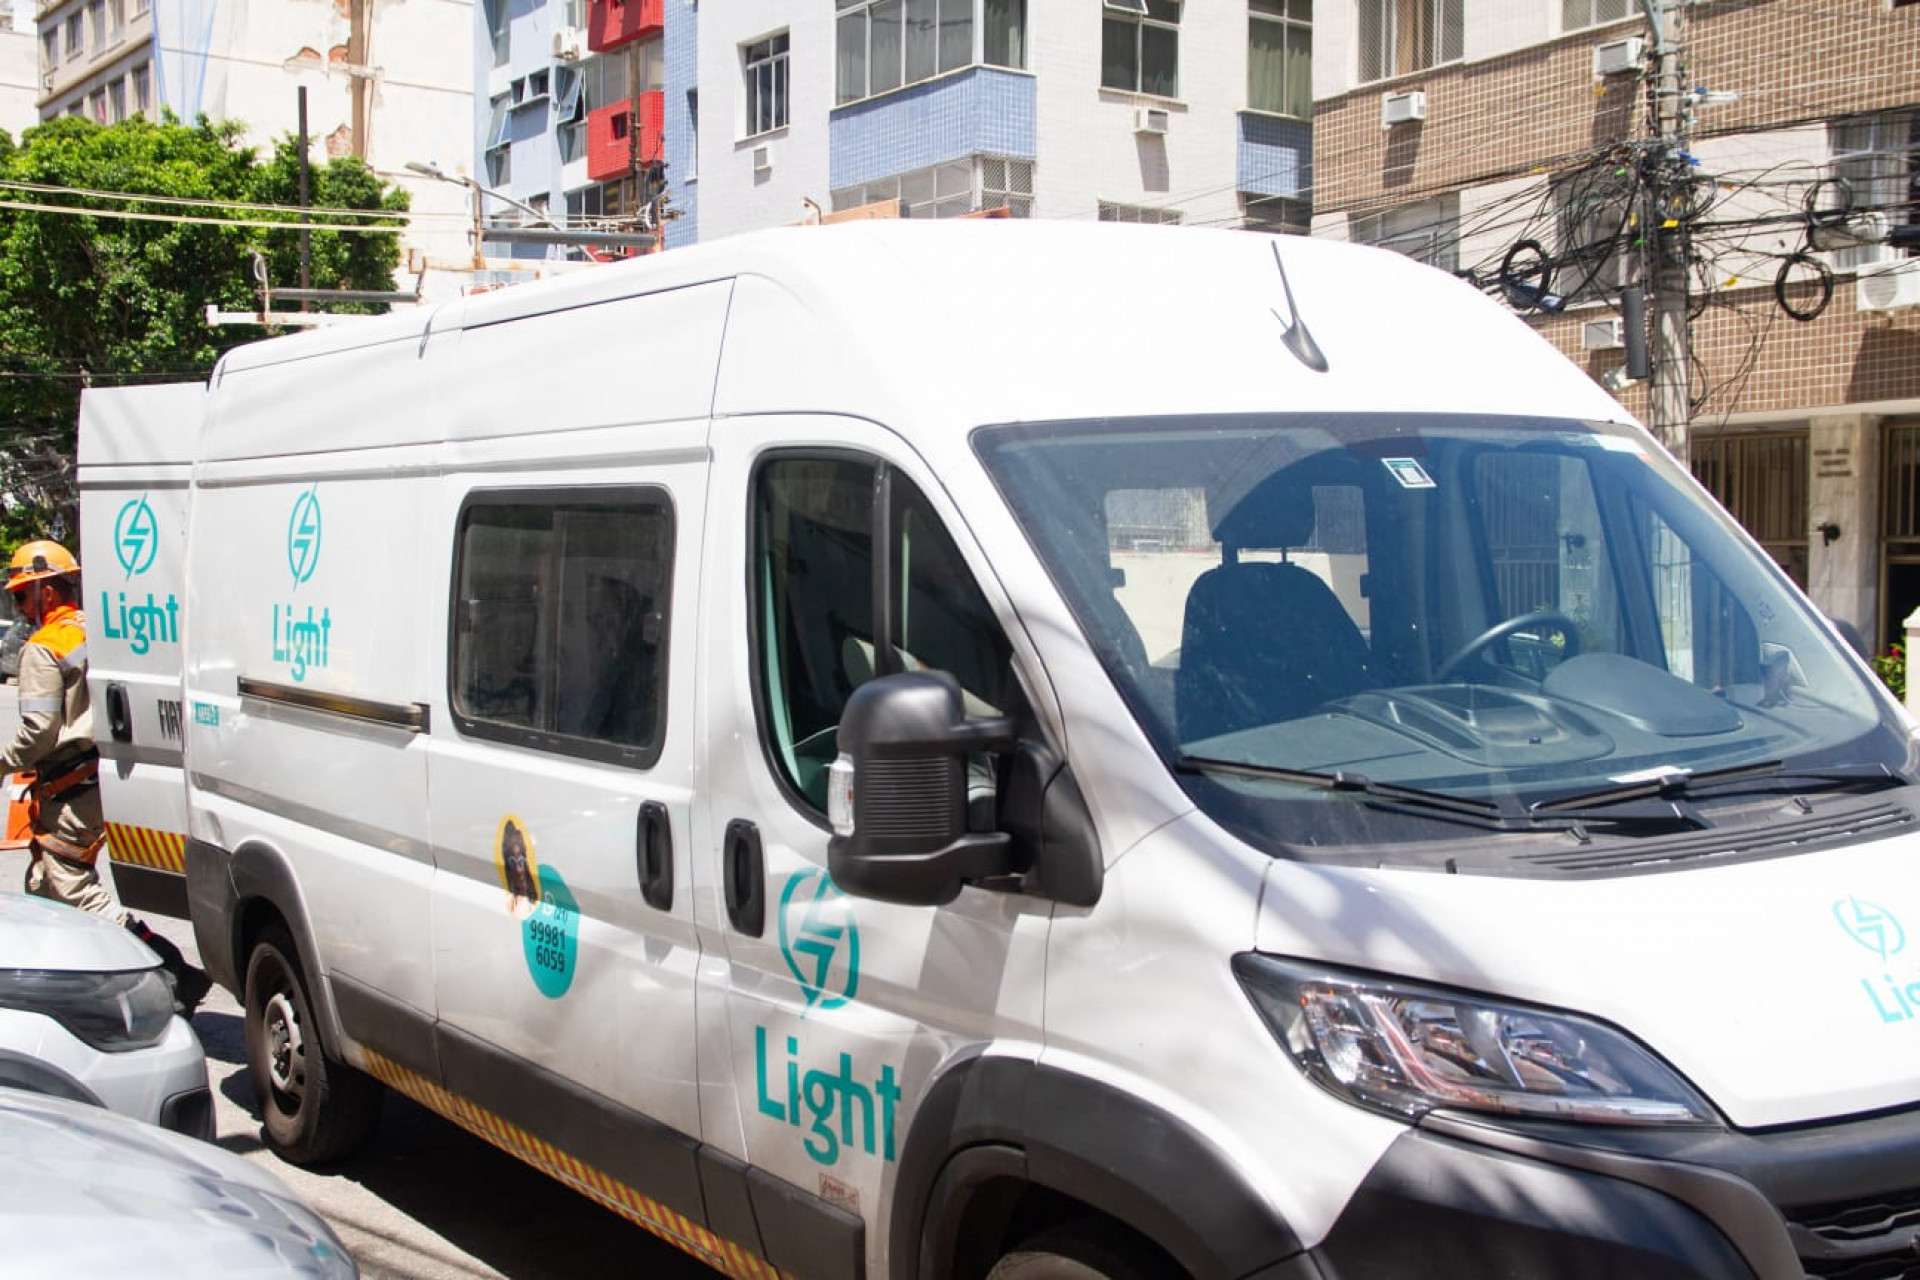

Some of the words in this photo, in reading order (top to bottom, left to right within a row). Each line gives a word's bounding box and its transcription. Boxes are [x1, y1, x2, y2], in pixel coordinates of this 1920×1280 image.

[102, 592, 178, 655] Light
[272, 604, 331, 682] Light
[530, 919, 566, 949] 99981
[535, 945, 566, 973] 6059
[756, 1025, 901, 1166] Light
